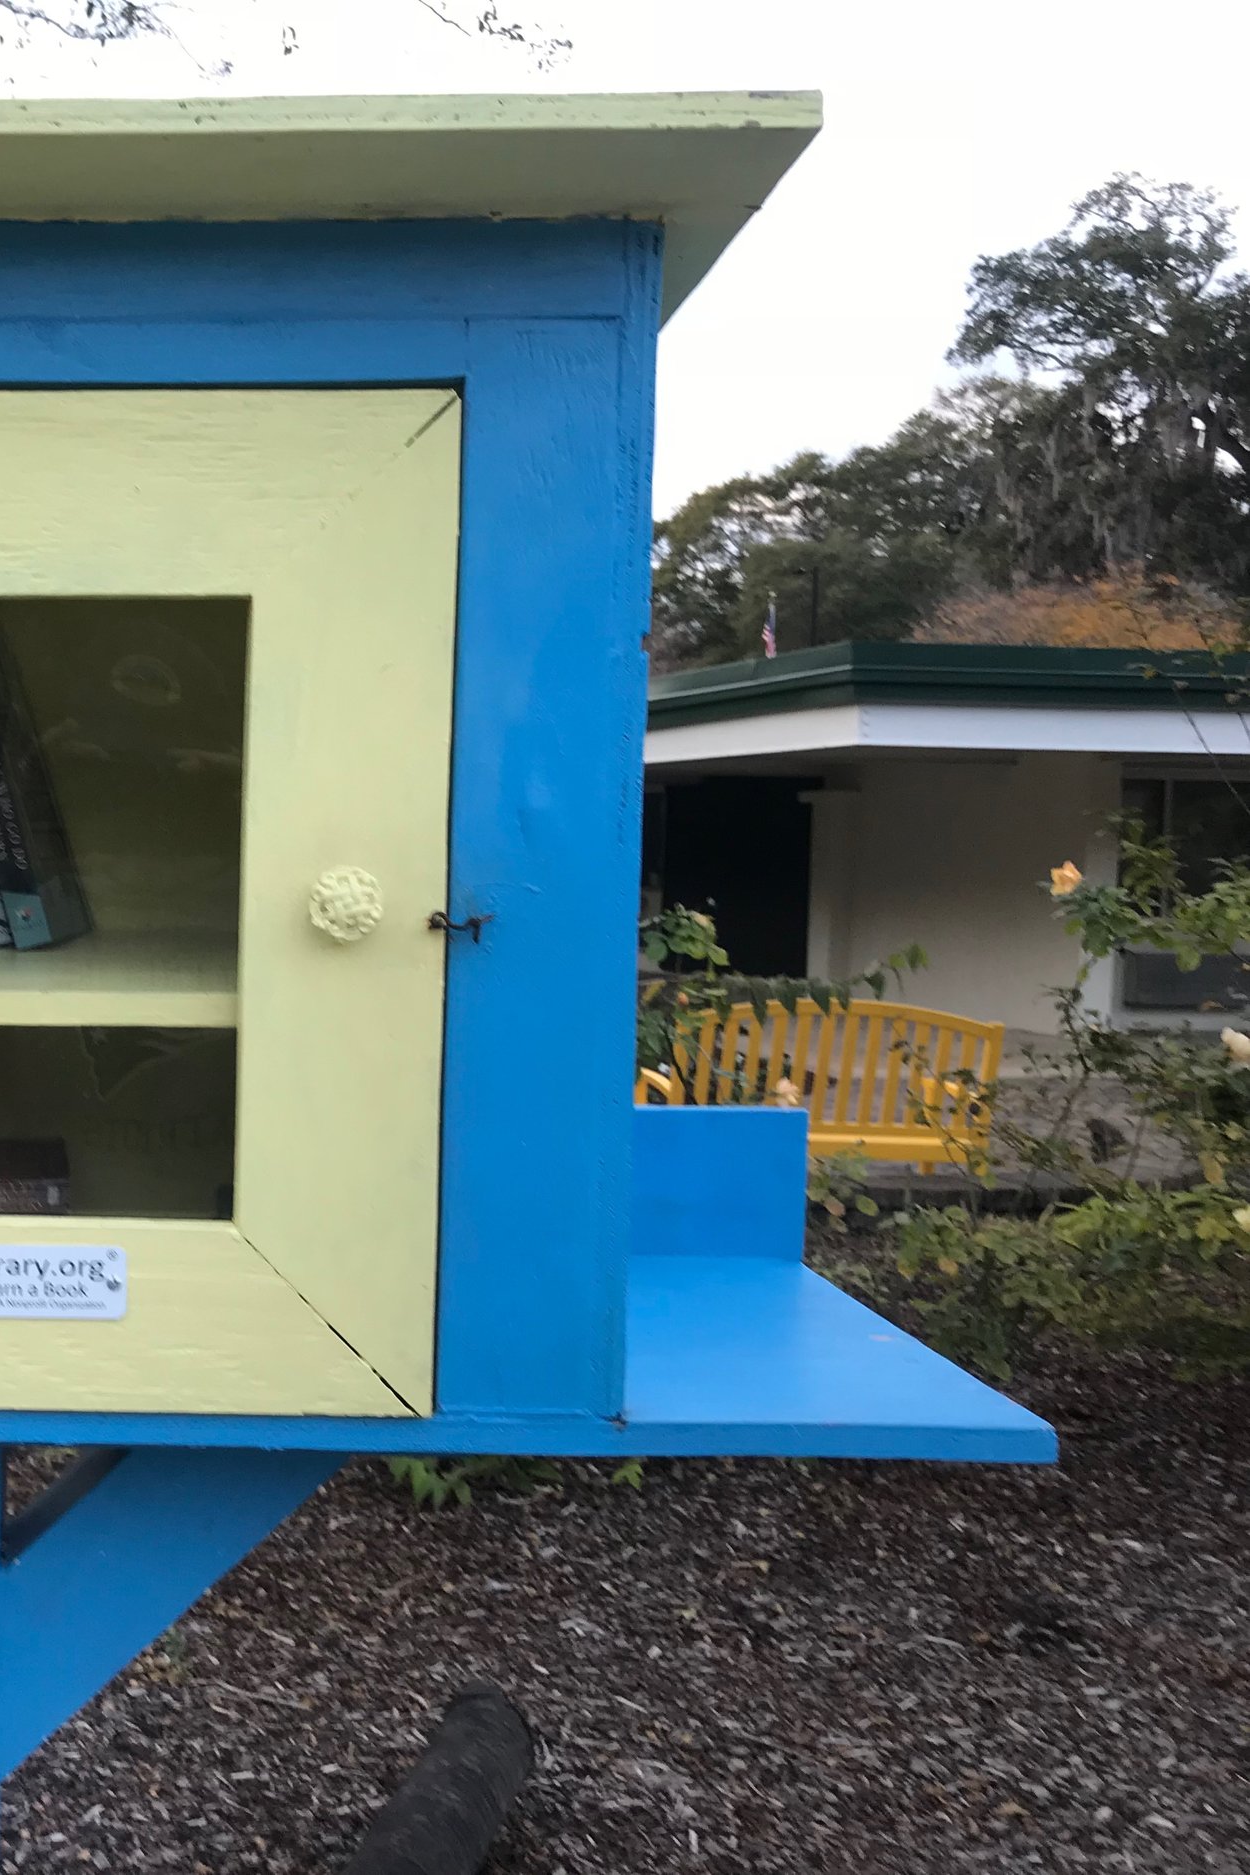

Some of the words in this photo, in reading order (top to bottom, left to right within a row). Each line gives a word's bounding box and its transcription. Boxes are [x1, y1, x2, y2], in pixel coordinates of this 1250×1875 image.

[11, 846, 29, 870] DO
[27, 1284, 39, 1297] a
[43, 1281, 89, 1298] Book
